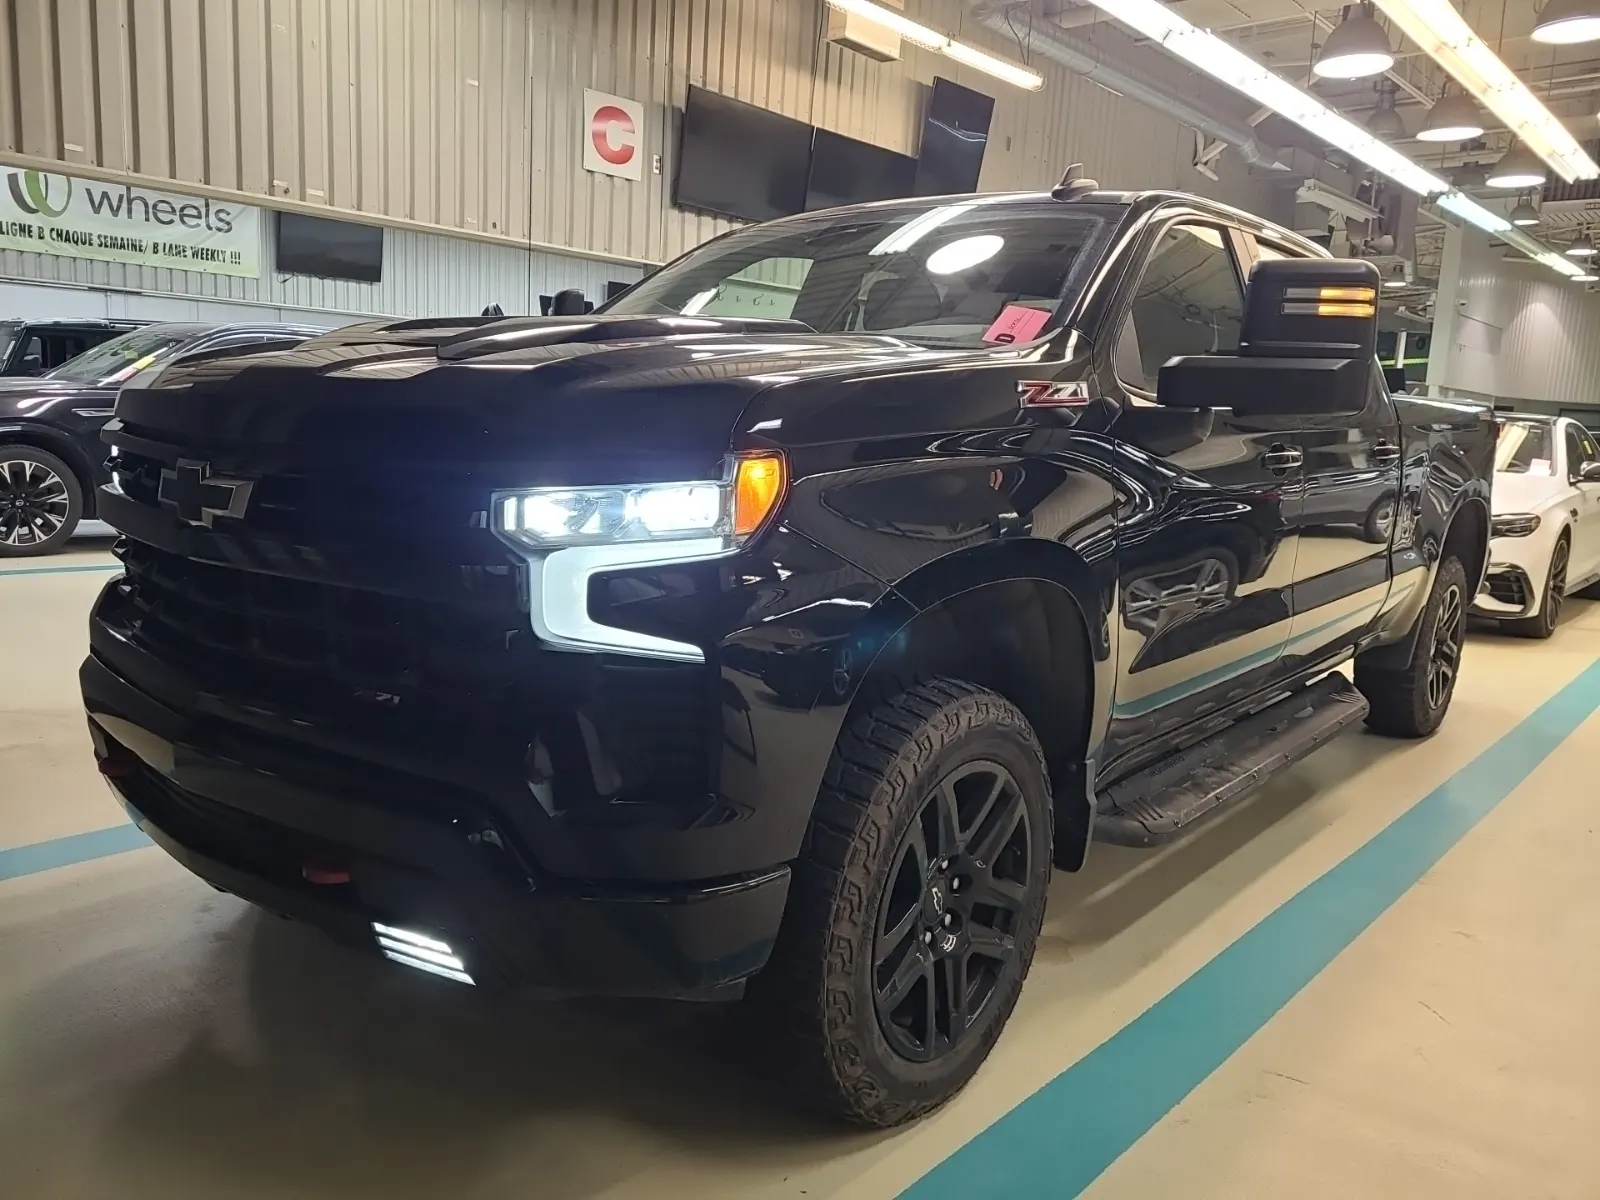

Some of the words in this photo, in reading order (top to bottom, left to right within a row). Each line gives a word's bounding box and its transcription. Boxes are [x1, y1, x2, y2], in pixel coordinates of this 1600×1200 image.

[591, 105, 636, 165] C
[85, 186, 233, 234] wheels
[37, 225, 46, 240] B
[49, 227, 94, 246] CHAQUE
[152, 241, 160, 255] B
[163, 242, 188, 259] LANE
[190, 245, 227, 264] WEEKLY
[994, 333, 1016, 343] D
[1016, 380, 1089, 407] Z71
